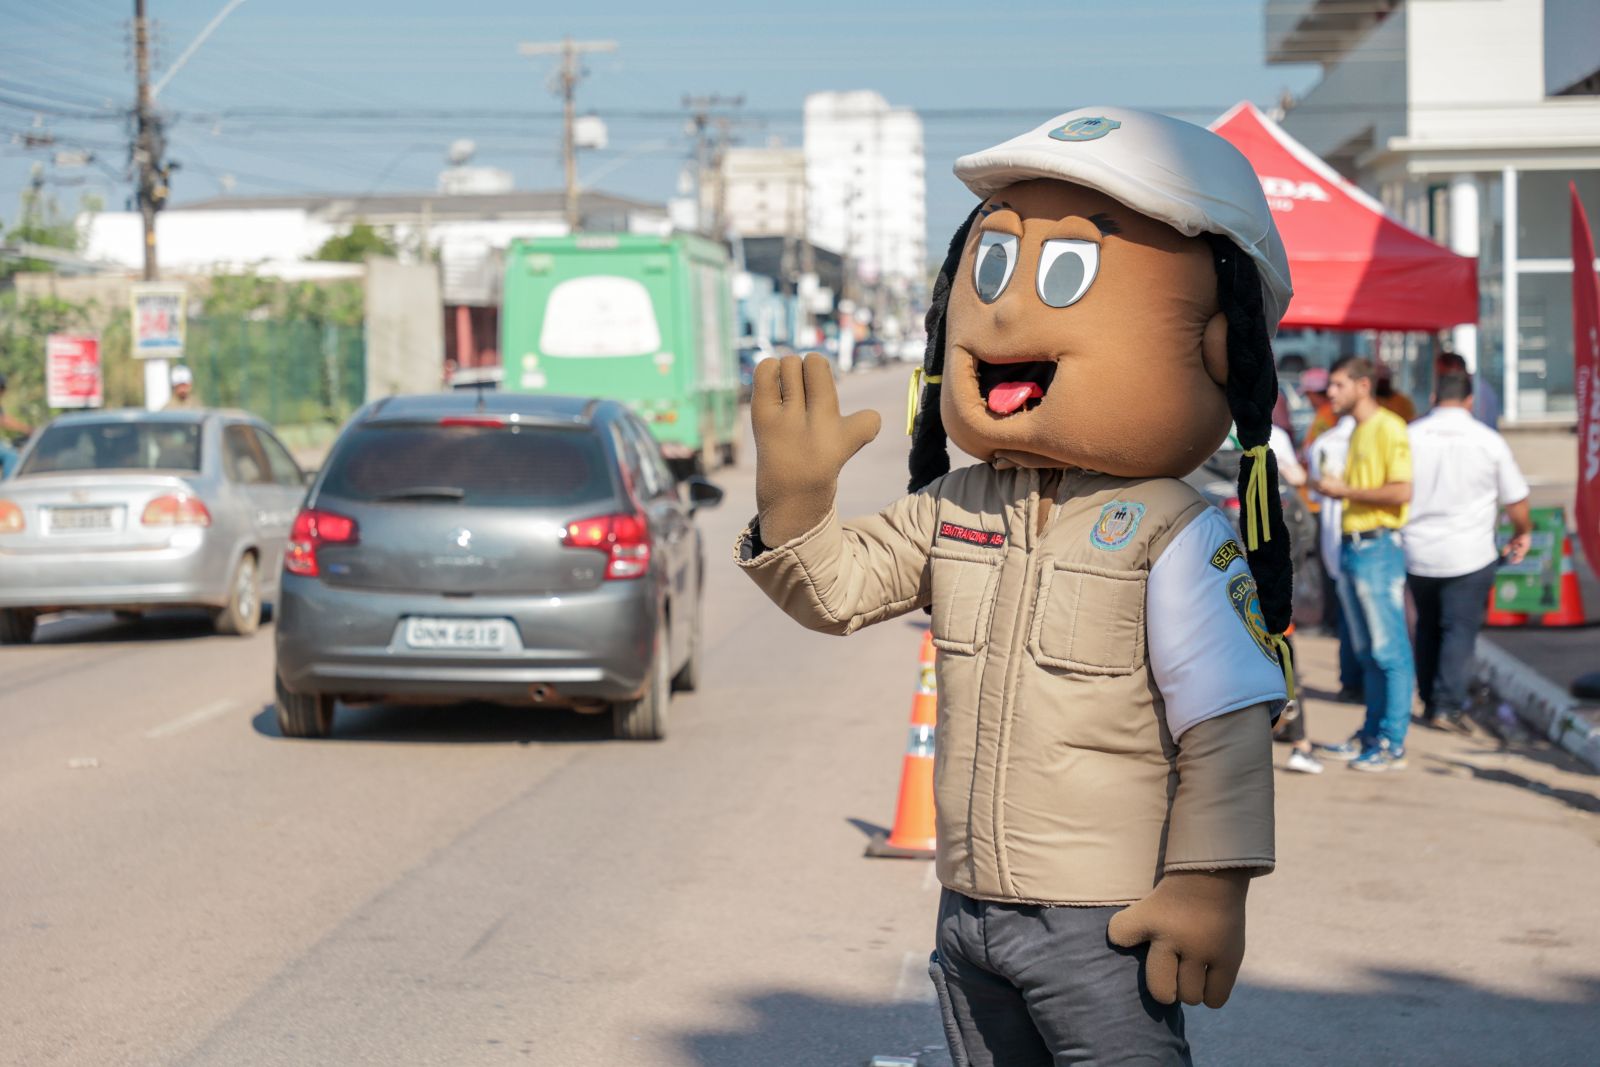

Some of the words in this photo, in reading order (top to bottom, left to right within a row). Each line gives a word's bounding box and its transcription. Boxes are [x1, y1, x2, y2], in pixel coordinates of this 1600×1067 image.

[1259, 178, 1331, 202] DA
[1215, 543, 1238, 567] SEM
[1232, 580, 1252, 601] SEM
